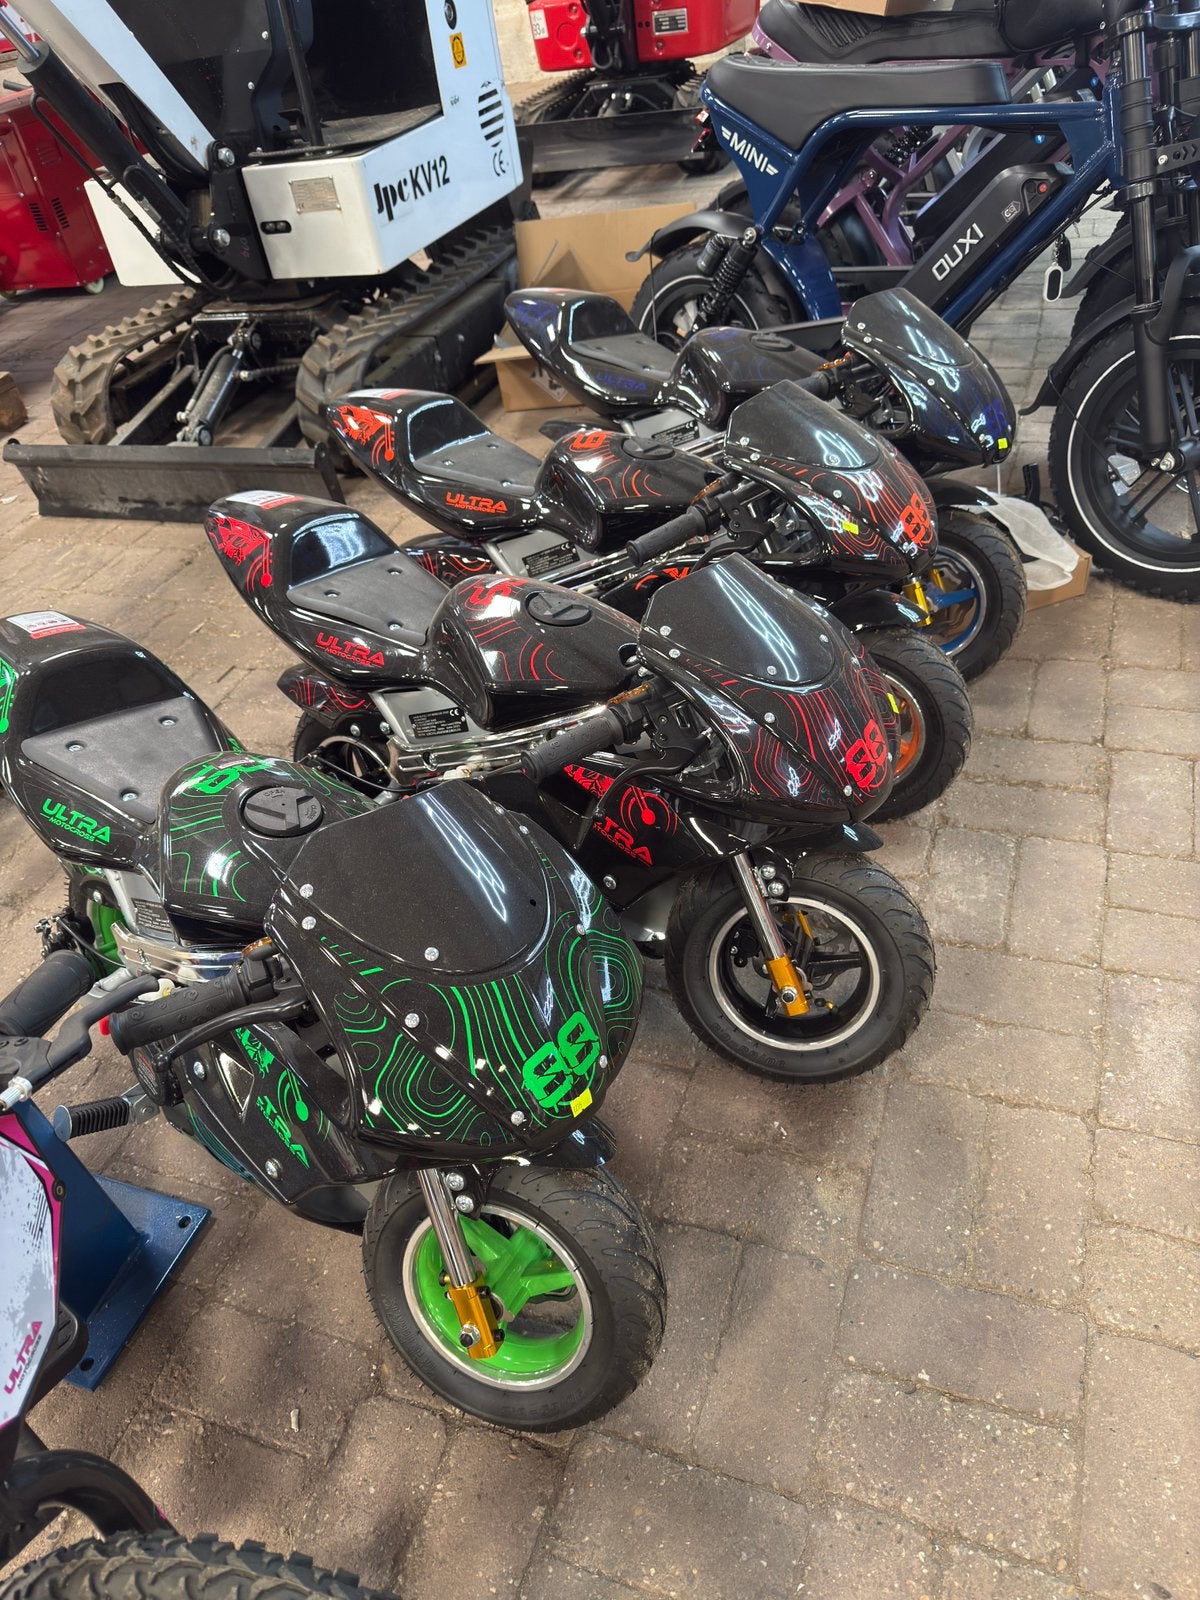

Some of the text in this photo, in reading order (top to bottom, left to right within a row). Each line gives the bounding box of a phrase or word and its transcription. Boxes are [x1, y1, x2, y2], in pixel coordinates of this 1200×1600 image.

[730, 132, 768, 172] MINI
[409, 155, 450, 200] KV12
[932, 223, 984, 281] OUXI
[446, 492, 507, 512] ULTRA
[317, 632, 385, 666] ULTRA
[325, 647, 371, 667] MOTOCROSS
[449, 708, 460, 717] CE
[42, 798, 111, 843] ULTRA
[49, 816, 95, 842] MOTOCROSS
[593, 816, 653, 865] TRA
[4, 1321, 43, 1394] ULTRA
